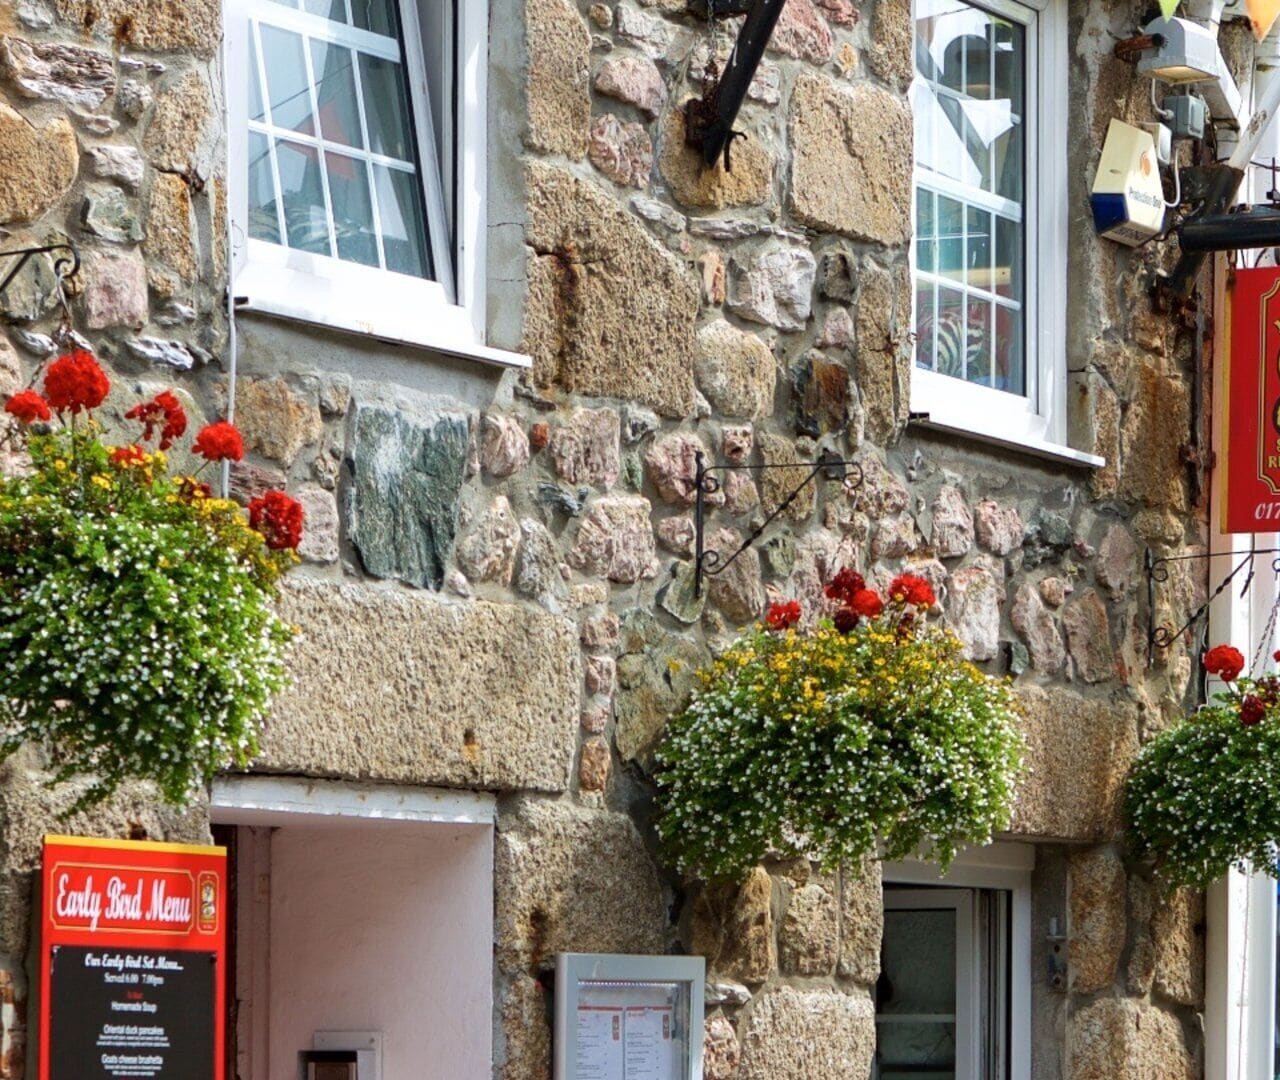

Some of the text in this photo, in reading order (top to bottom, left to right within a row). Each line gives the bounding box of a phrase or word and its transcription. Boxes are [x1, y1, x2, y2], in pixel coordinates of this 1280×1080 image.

[56, 873, 101, 932] Early
[105, 876, 144, 921] Bird
[145, 878, 192, 923] Menu
[102, 953, 124, 972] Early
